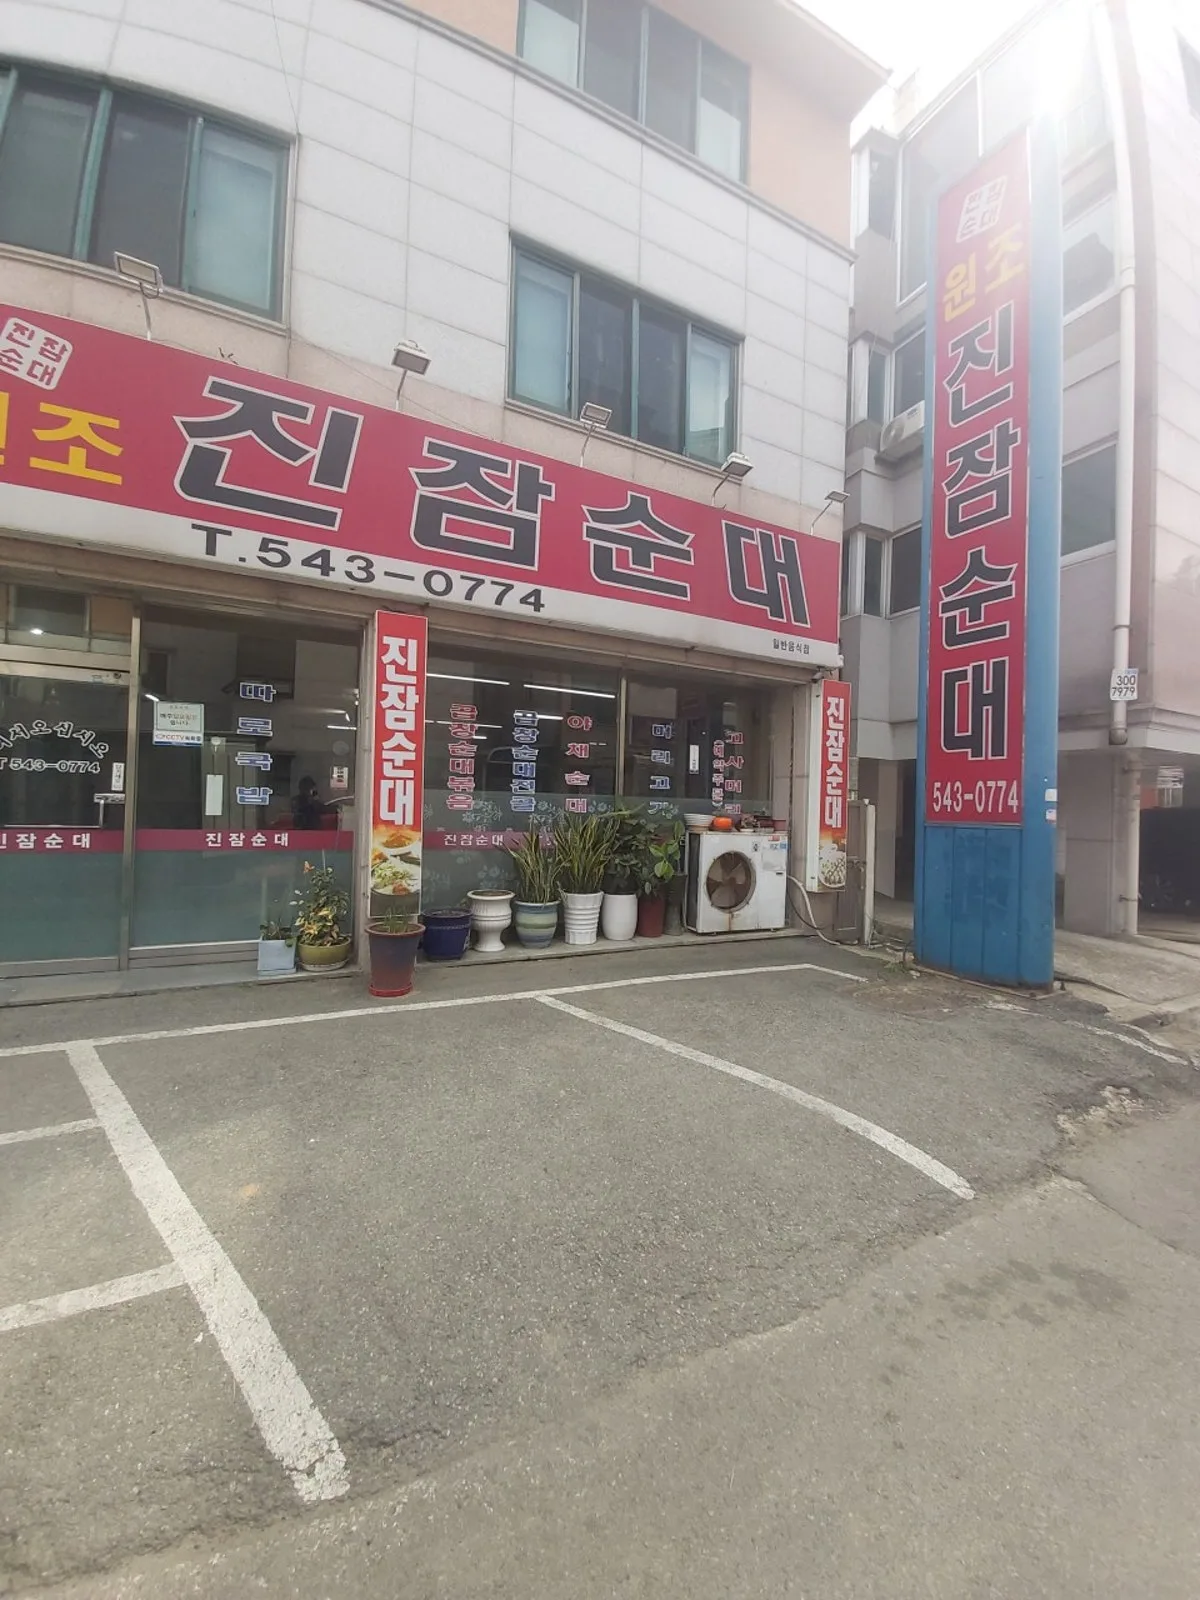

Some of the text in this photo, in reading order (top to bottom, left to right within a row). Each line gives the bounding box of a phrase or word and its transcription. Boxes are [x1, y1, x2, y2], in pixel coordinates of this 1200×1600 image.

[942, 222, 1025, 323] 원조
[6, 321, 68, 363] 진잠
[0, 375, 811, 629] 조 진잠순대
[939, 299, 1021, 760] 진잠순대
[191, 523, 545, 613] T.543-0774
[1112, 686, 1136, 697] 7979
[1116, 674, 1136, 686] 300
[234, 681, 277, 806] 따로국밥
[379, 635, 420, 826] 진잠순대
[824, 695, 846, 829] 진잠순대
[205, 832, 289, 847] 진잠순대
[932, 780, 1019, 814] 543-0774
